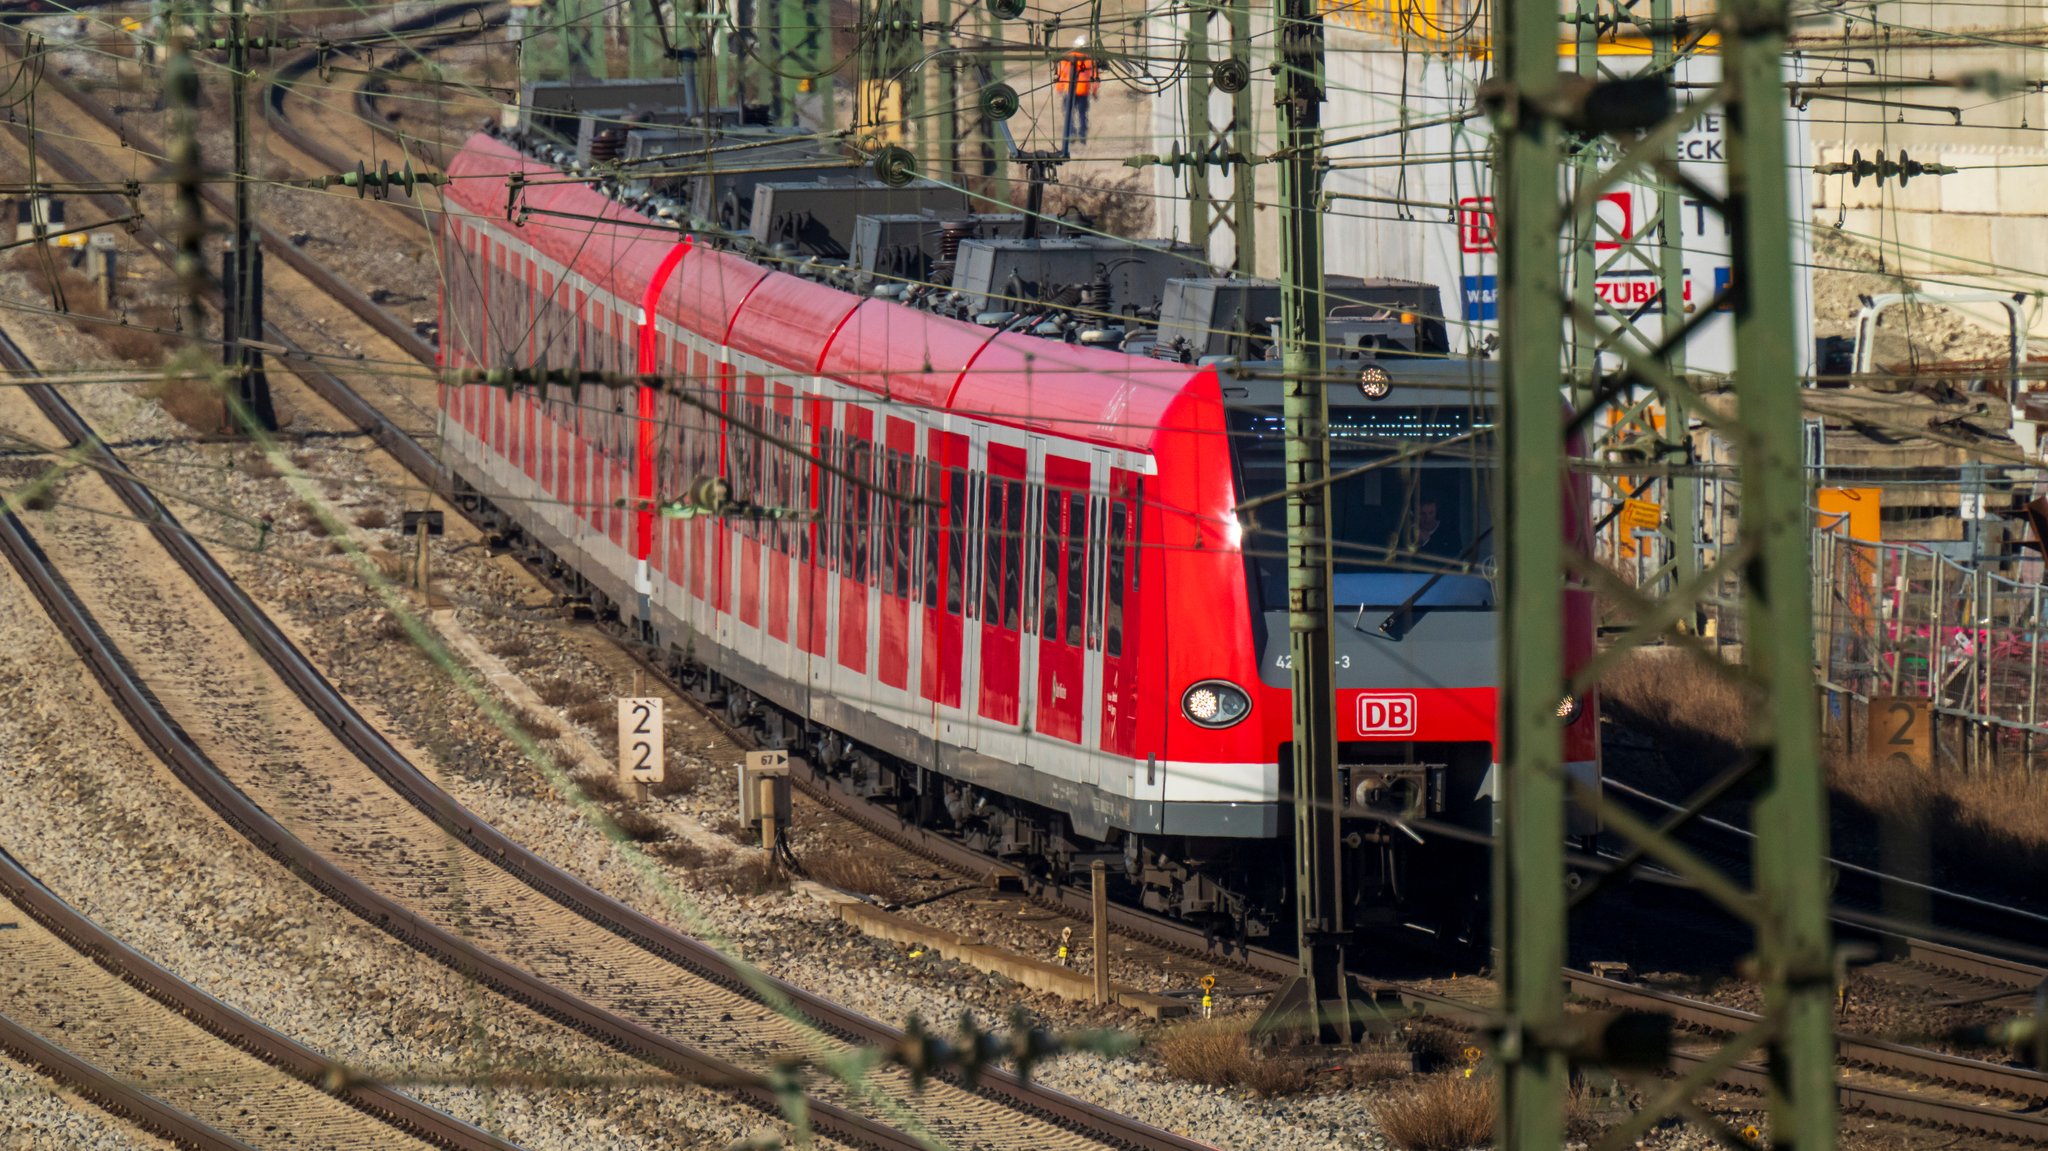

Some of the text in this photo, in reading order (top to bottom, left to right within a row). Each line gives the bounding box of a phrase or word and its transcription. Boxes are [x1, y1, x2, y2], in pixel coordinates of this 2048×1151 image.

[1595, 280, 1692, 305] ZÜBLN
[1275, 655, 1293, 669] 42
[631, 704, 651, 735] 2
[1365, 701, 1409, 729] DB
[1887, 702, 1916, 746] 2
[632, 740, 652, 771] 2
[760, 754, 774, 766] 67
